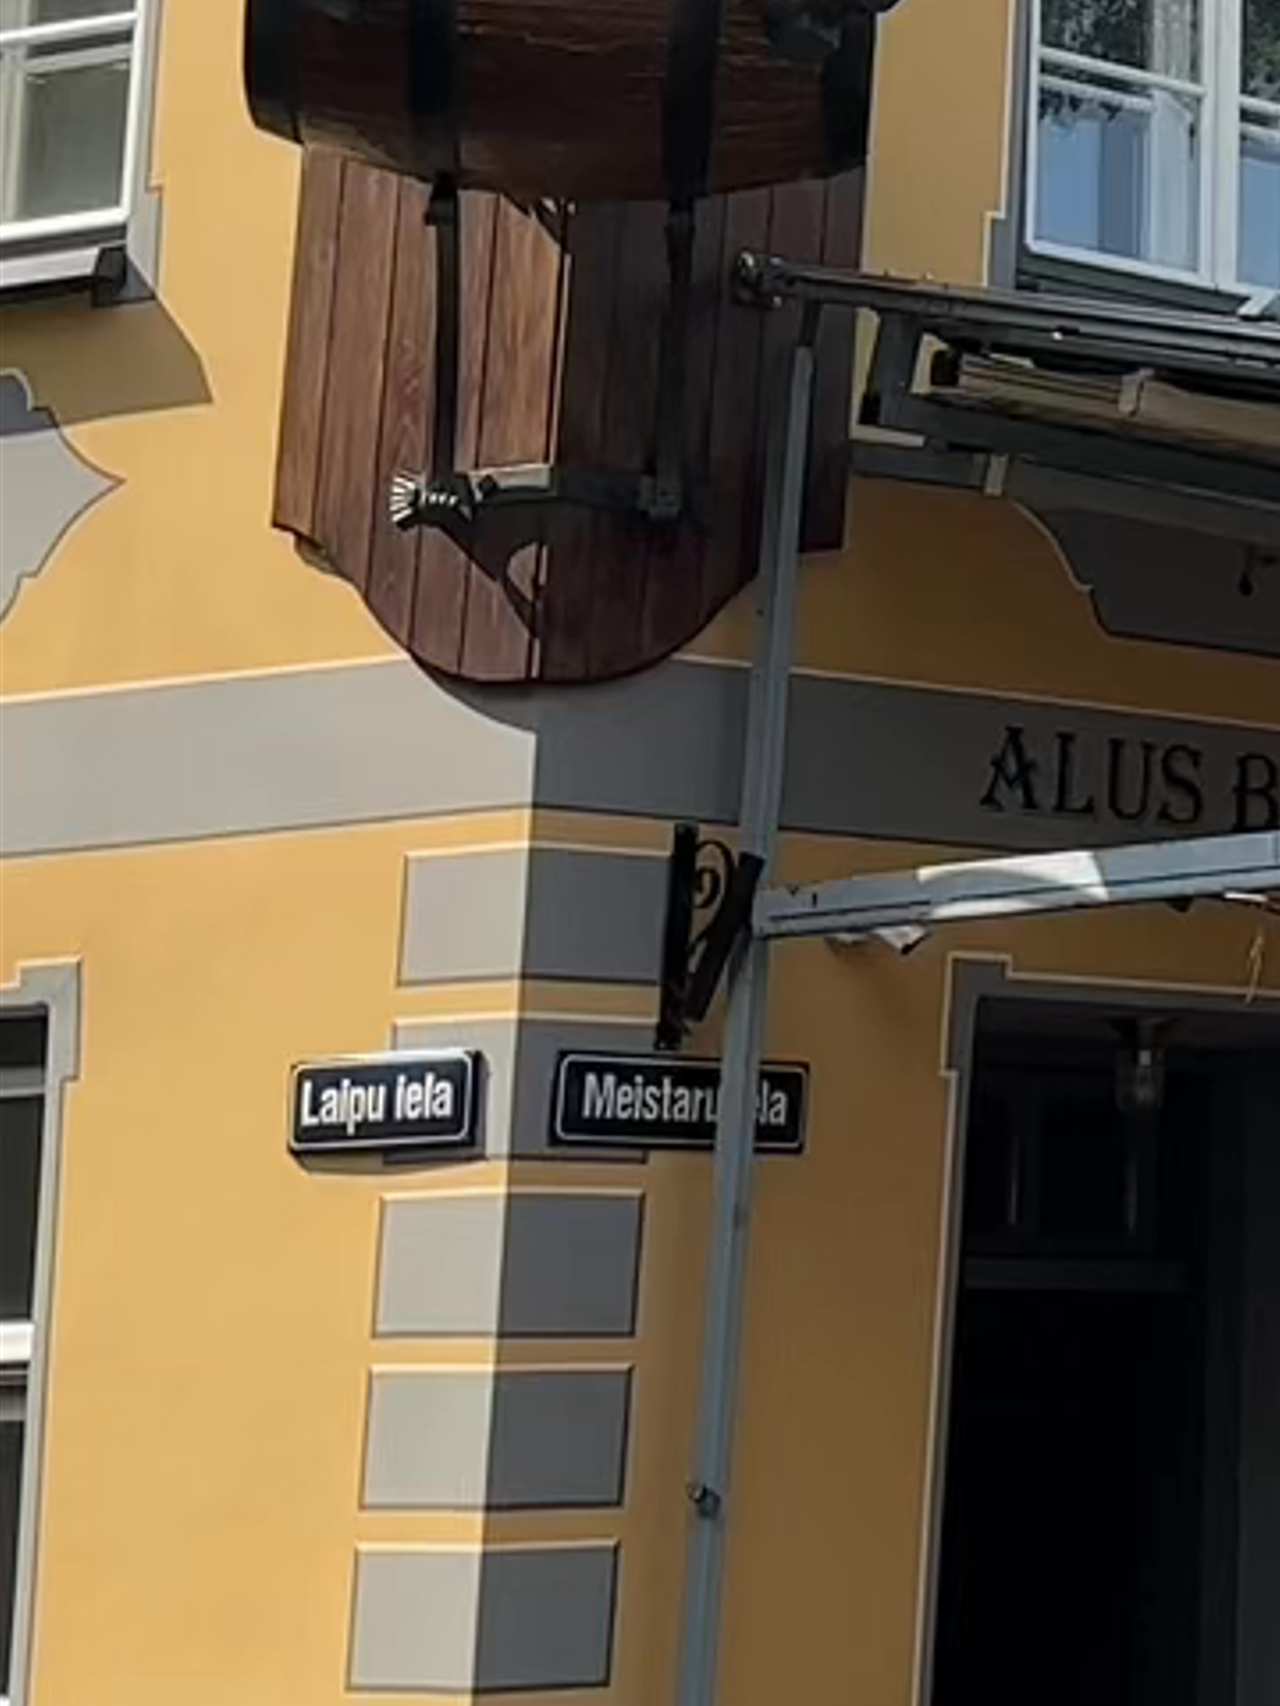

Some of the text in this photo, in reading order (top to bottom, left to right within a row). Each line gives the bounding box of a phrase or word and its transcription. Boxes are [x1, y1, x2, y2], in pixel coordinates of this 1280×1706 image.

[979, 725, 1204, 824] ALUS
[299, 1072, 454, 1134] Laipu iela
